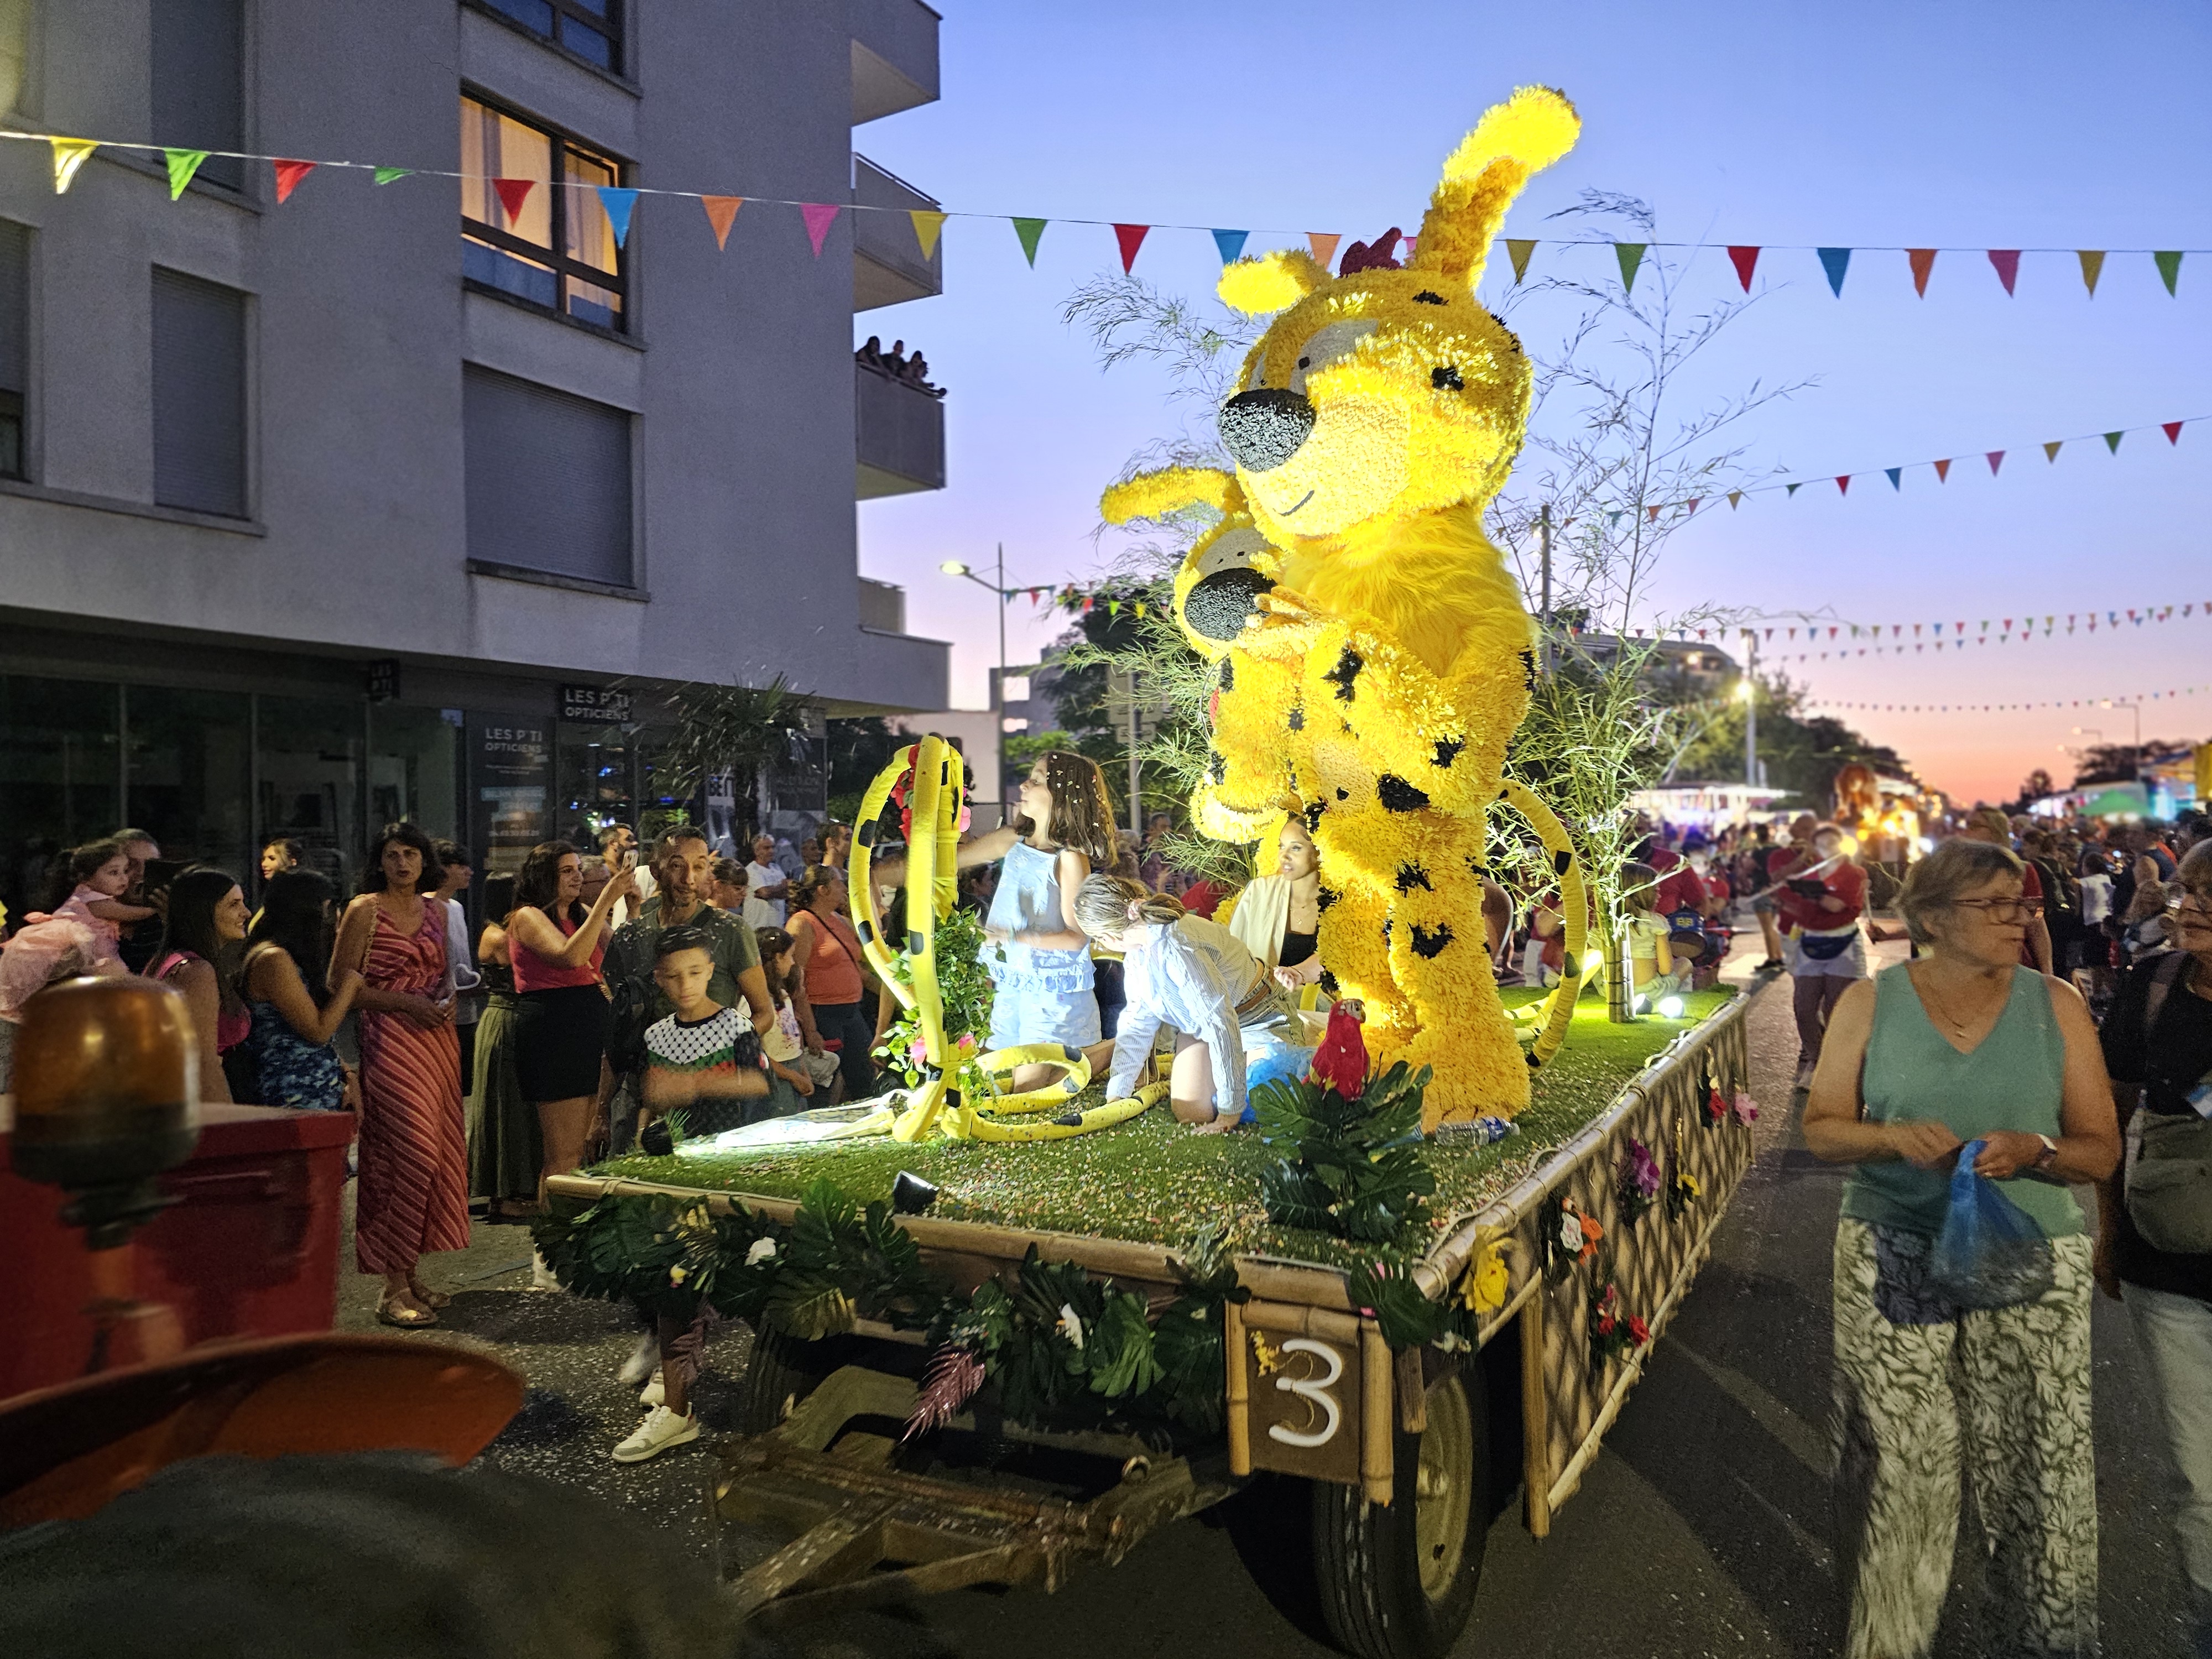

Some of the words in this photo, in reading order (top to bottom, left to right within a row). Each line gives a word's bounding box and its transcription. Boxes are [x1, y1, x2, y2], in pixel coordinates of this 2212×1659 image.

[565, 688, 595, 704] LES
[486, 728, 513, 740] LES
[485, 742, 542, 753] OPTICIENS
[1269, 1338, 1343, 1448] 3
